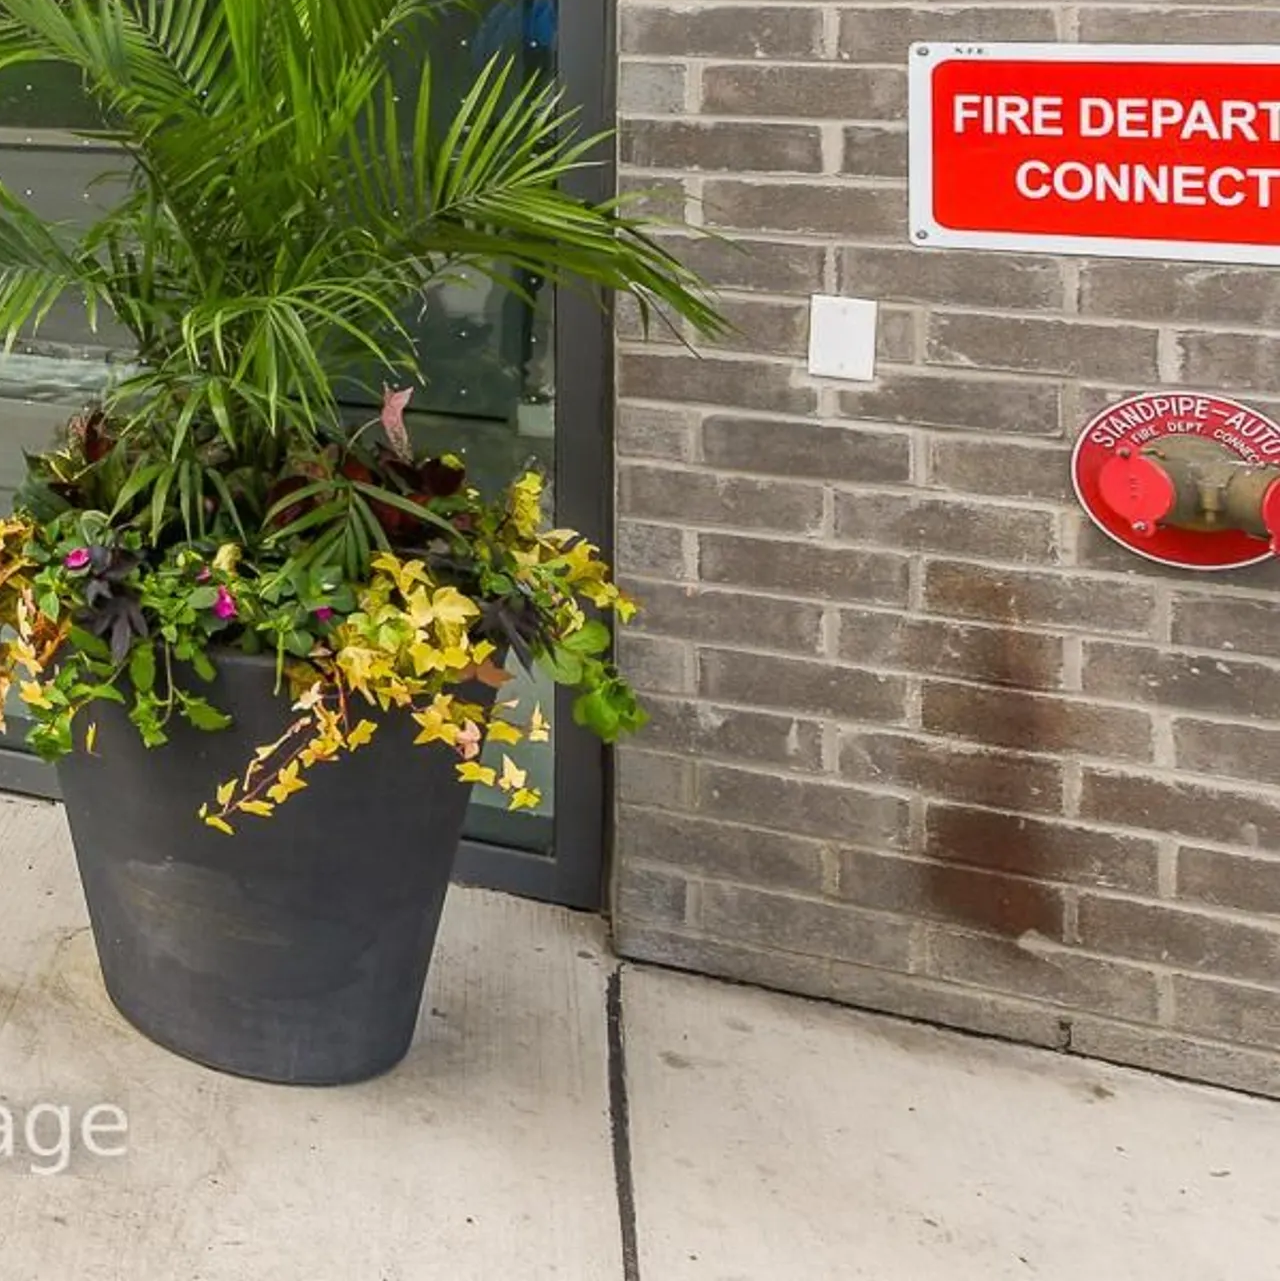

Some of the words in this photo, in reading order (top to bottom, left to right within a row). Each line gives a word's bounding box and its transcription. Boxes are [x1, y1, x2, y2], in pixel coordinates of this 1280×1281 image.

[953, 94, 1063, 136] FIRE
[1079, 97, 1280, 142] DEPART
[1015, 160, 1280, 208] CONNECT
[1131, 426, 1160, 444] FIRE
